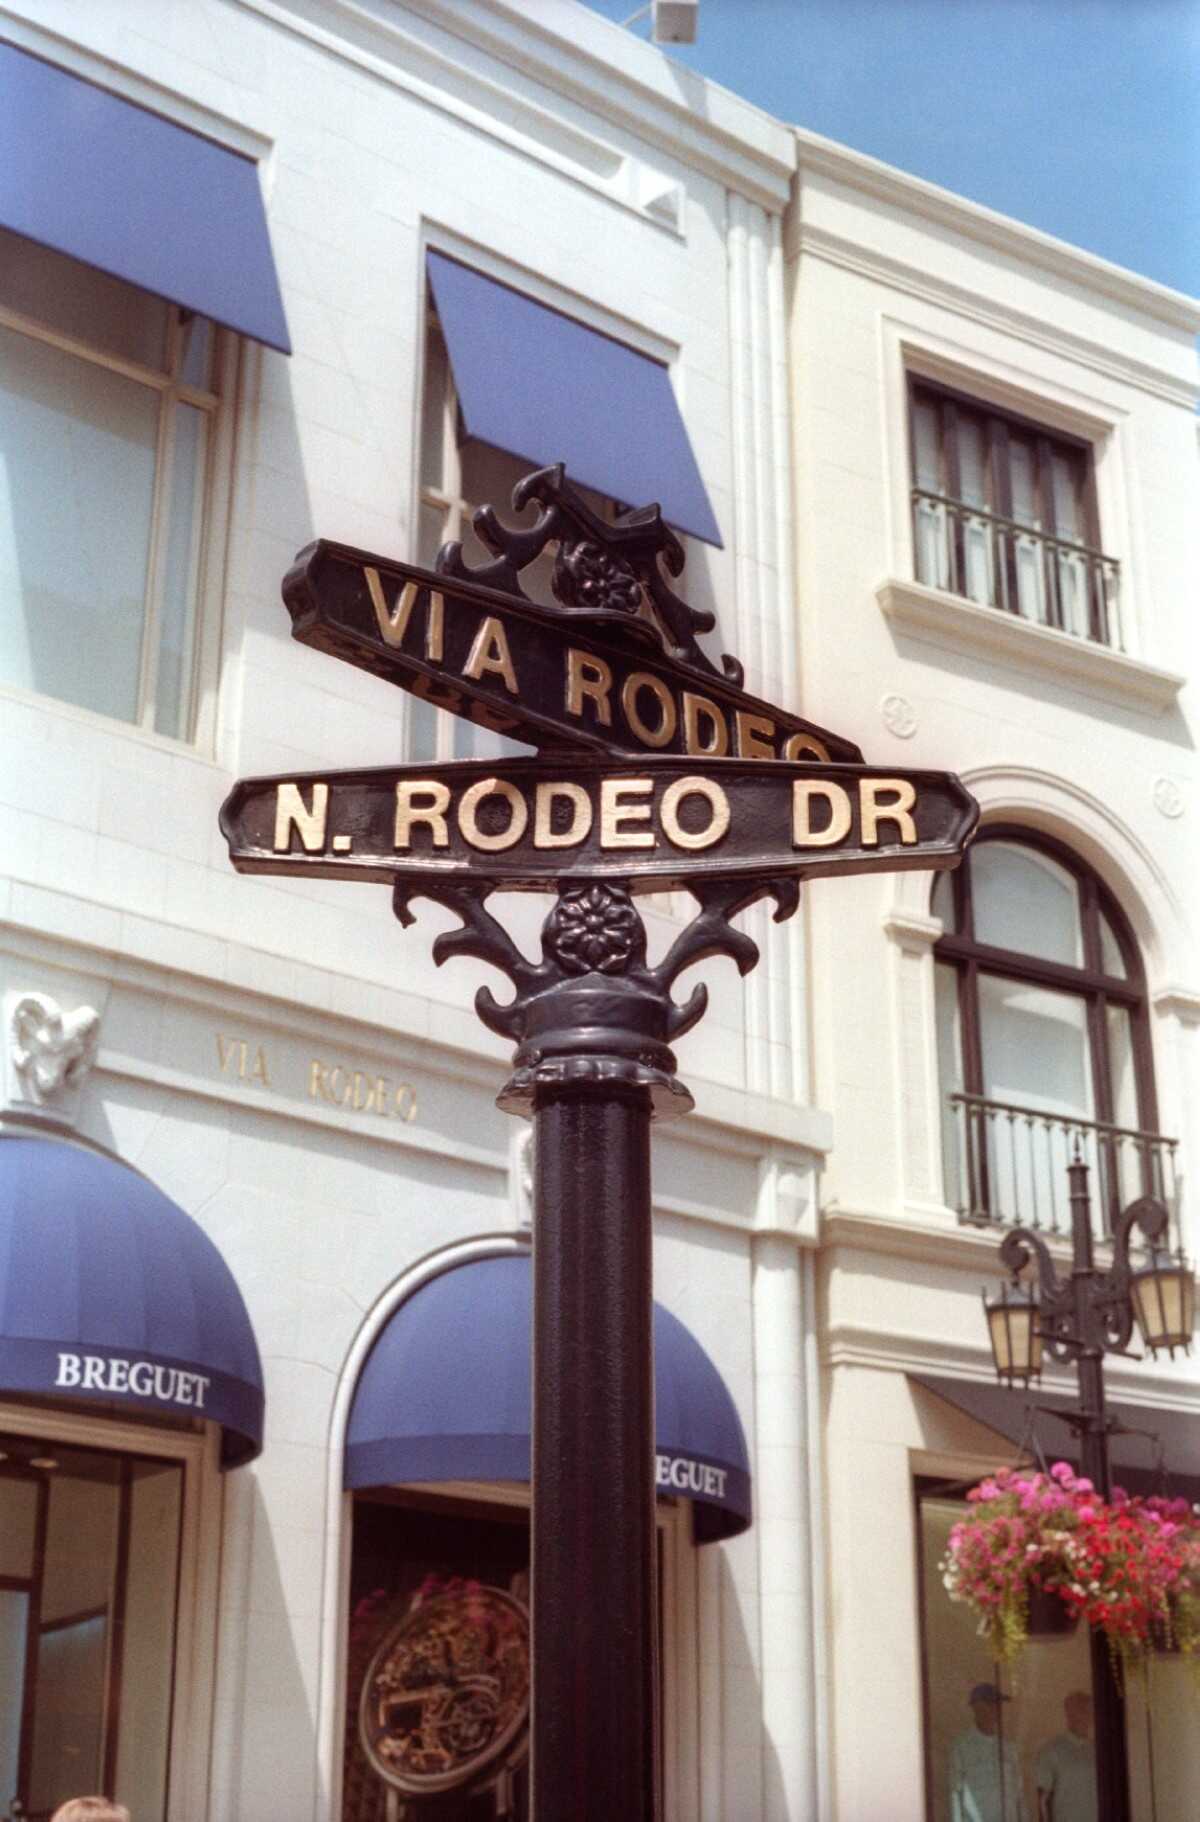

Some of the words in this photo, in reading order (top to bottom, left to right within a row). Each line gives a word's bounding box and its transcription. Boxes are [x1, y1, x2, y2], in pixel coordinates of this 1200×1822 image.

[363, 567, 519, 695] VIA
[273, 783, 352, 854] N.
[394, 777, 732, 852] RODEO
[791, 778, 918, 846] DR
[216, 1033, 271, 1087] VIA
[309, 1059, 418, 1122] RODEO
[55, 1352, 209, 1408] BREGUET
[655, 1454, 728, 1499] EGUET
